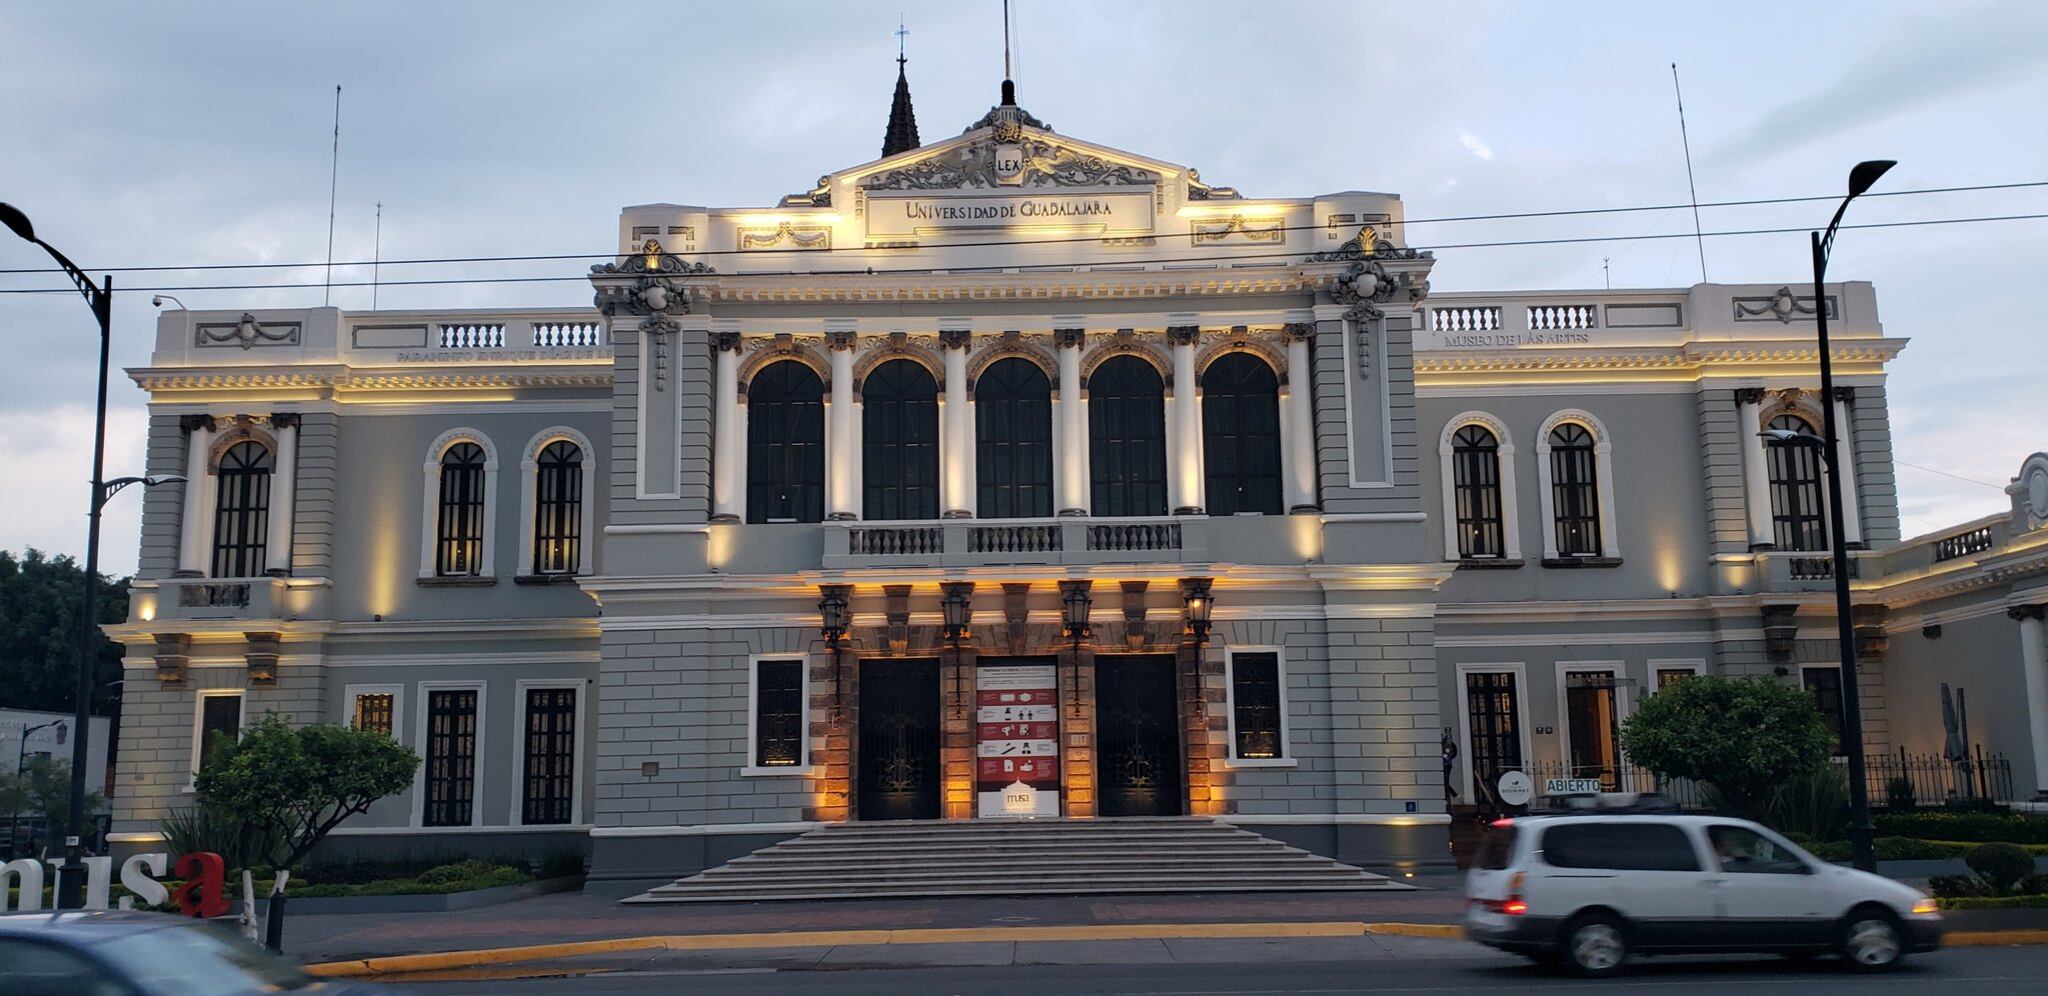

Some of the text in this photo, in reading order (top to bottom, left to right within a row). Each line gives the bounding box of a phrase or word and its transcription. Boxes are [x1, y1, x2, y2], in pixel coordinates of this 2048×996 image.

[998, 160, 1020, 172] LEX
[906, 200, 1112, 219] UNIVERSIDAD DE GUADALAJARA
[1445, 335, 1493, 348] MUSEO
[1496, 335, 1515, 346] DE
[1546, 332, 1589, 345] ARTES
[575, 350, 593, 359] DE
[1547, 779, 1600, 792] ABIERTO
[1007, 794, 1030, 803] musa
